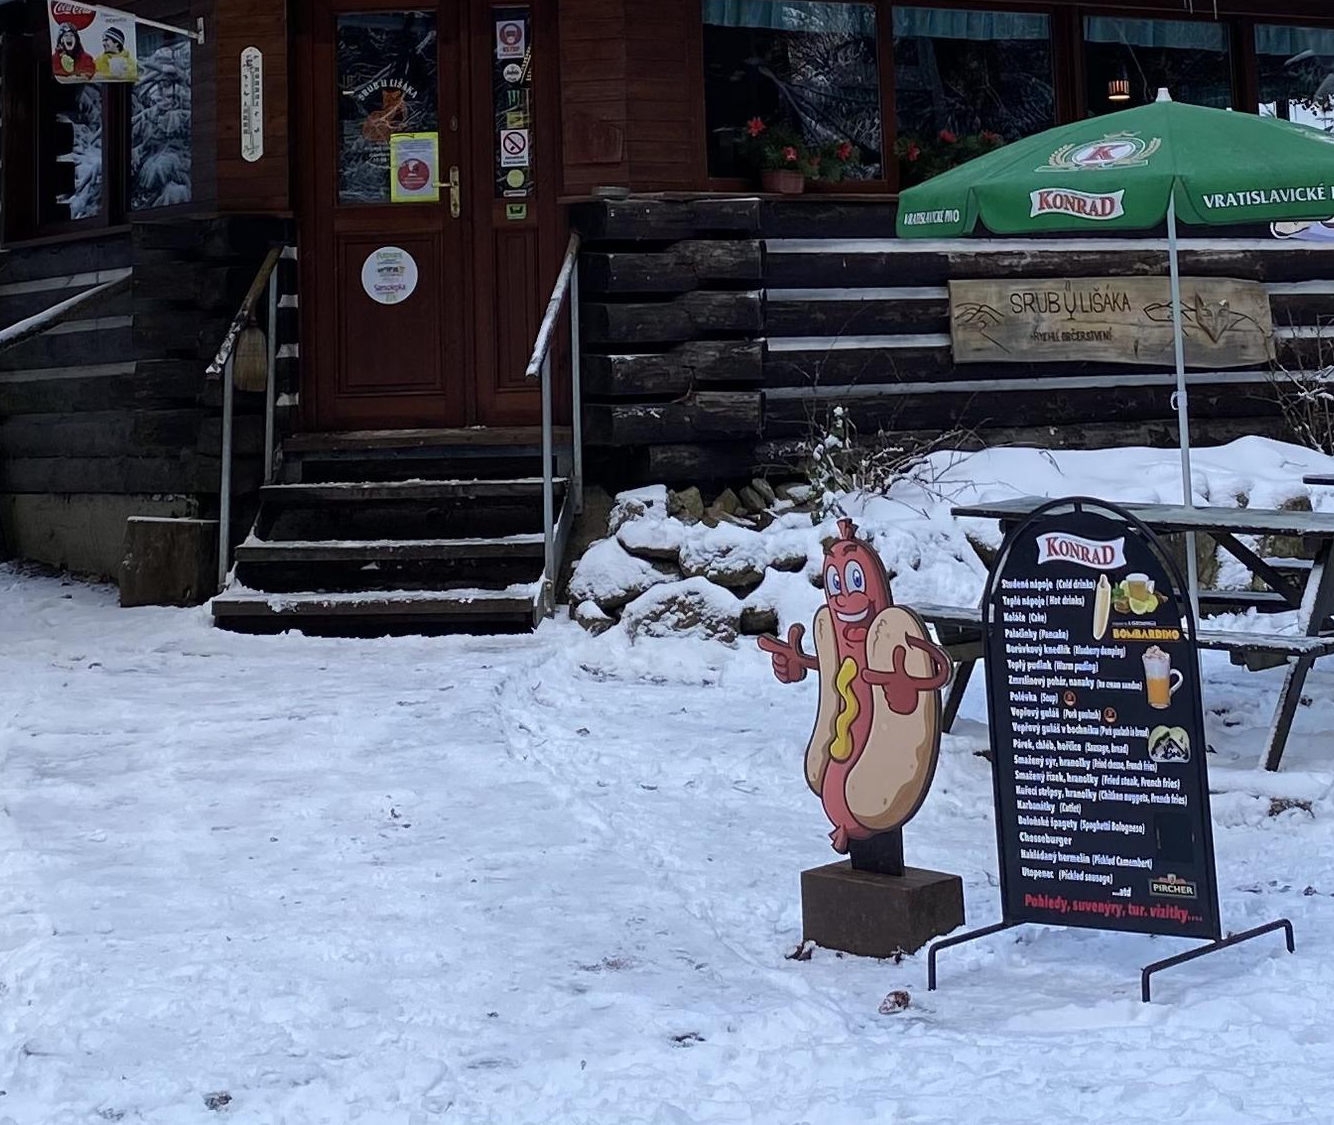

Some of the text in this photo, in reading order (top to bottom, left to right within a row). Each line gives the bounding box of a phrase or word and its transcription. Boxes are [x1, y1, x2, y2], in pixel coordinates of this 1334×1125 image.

[1081, 144, 1128, 161] K
[1038, 190, 1115, 217] KONRAD
[1203, 183, 1326, 209] VRATISLAVICKÉ
[1010, 292, 1061, 314] SRUB
[1080, 284, 1131, 313] LIŠÁKA
[1046, 536, 1115, 565] KONRAD
[1113, 628, 1180, 640] BOMBARDINO
[1153, 883, 1193, 895] PIRCHER
[1024, 893, 1071, 913] Pohledy,
[1128, 903, 1148, 917] tur.
